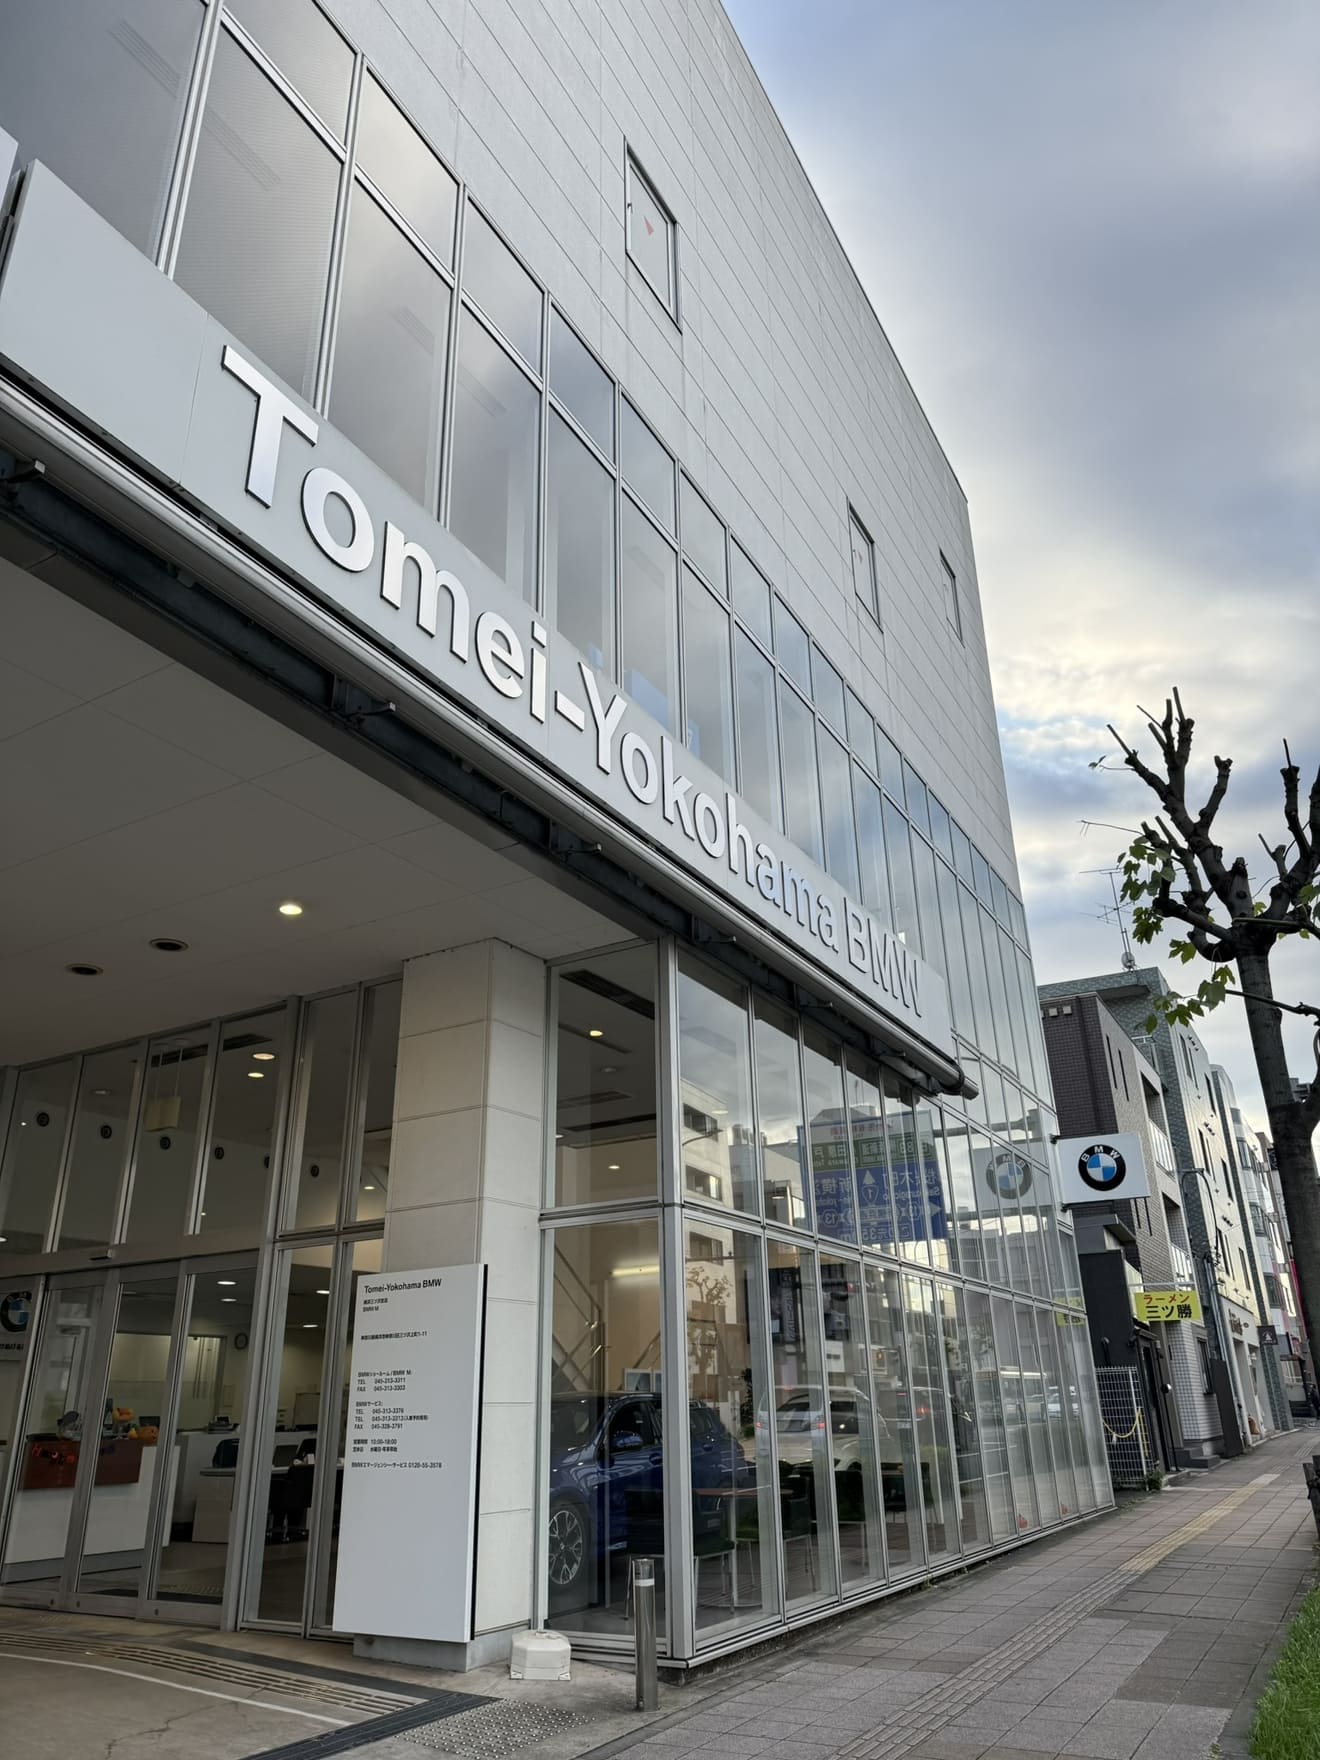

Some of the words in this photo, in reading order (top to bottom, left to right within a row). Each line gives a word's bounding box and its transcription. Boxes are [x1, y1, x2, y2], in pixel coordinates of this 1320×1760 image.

[221, 345, 839, 953] Tomei-Yokohama
[843, 896, 922, 1018] BMW
[364, 1280, 422, 1294] Tomei-Yokohama
[422, 1278, 442, 1289] BMW
[1143, 1293, 1190, 1305] ラーメン
[1145, 1304, 1193, 1319] 三ツ勝
